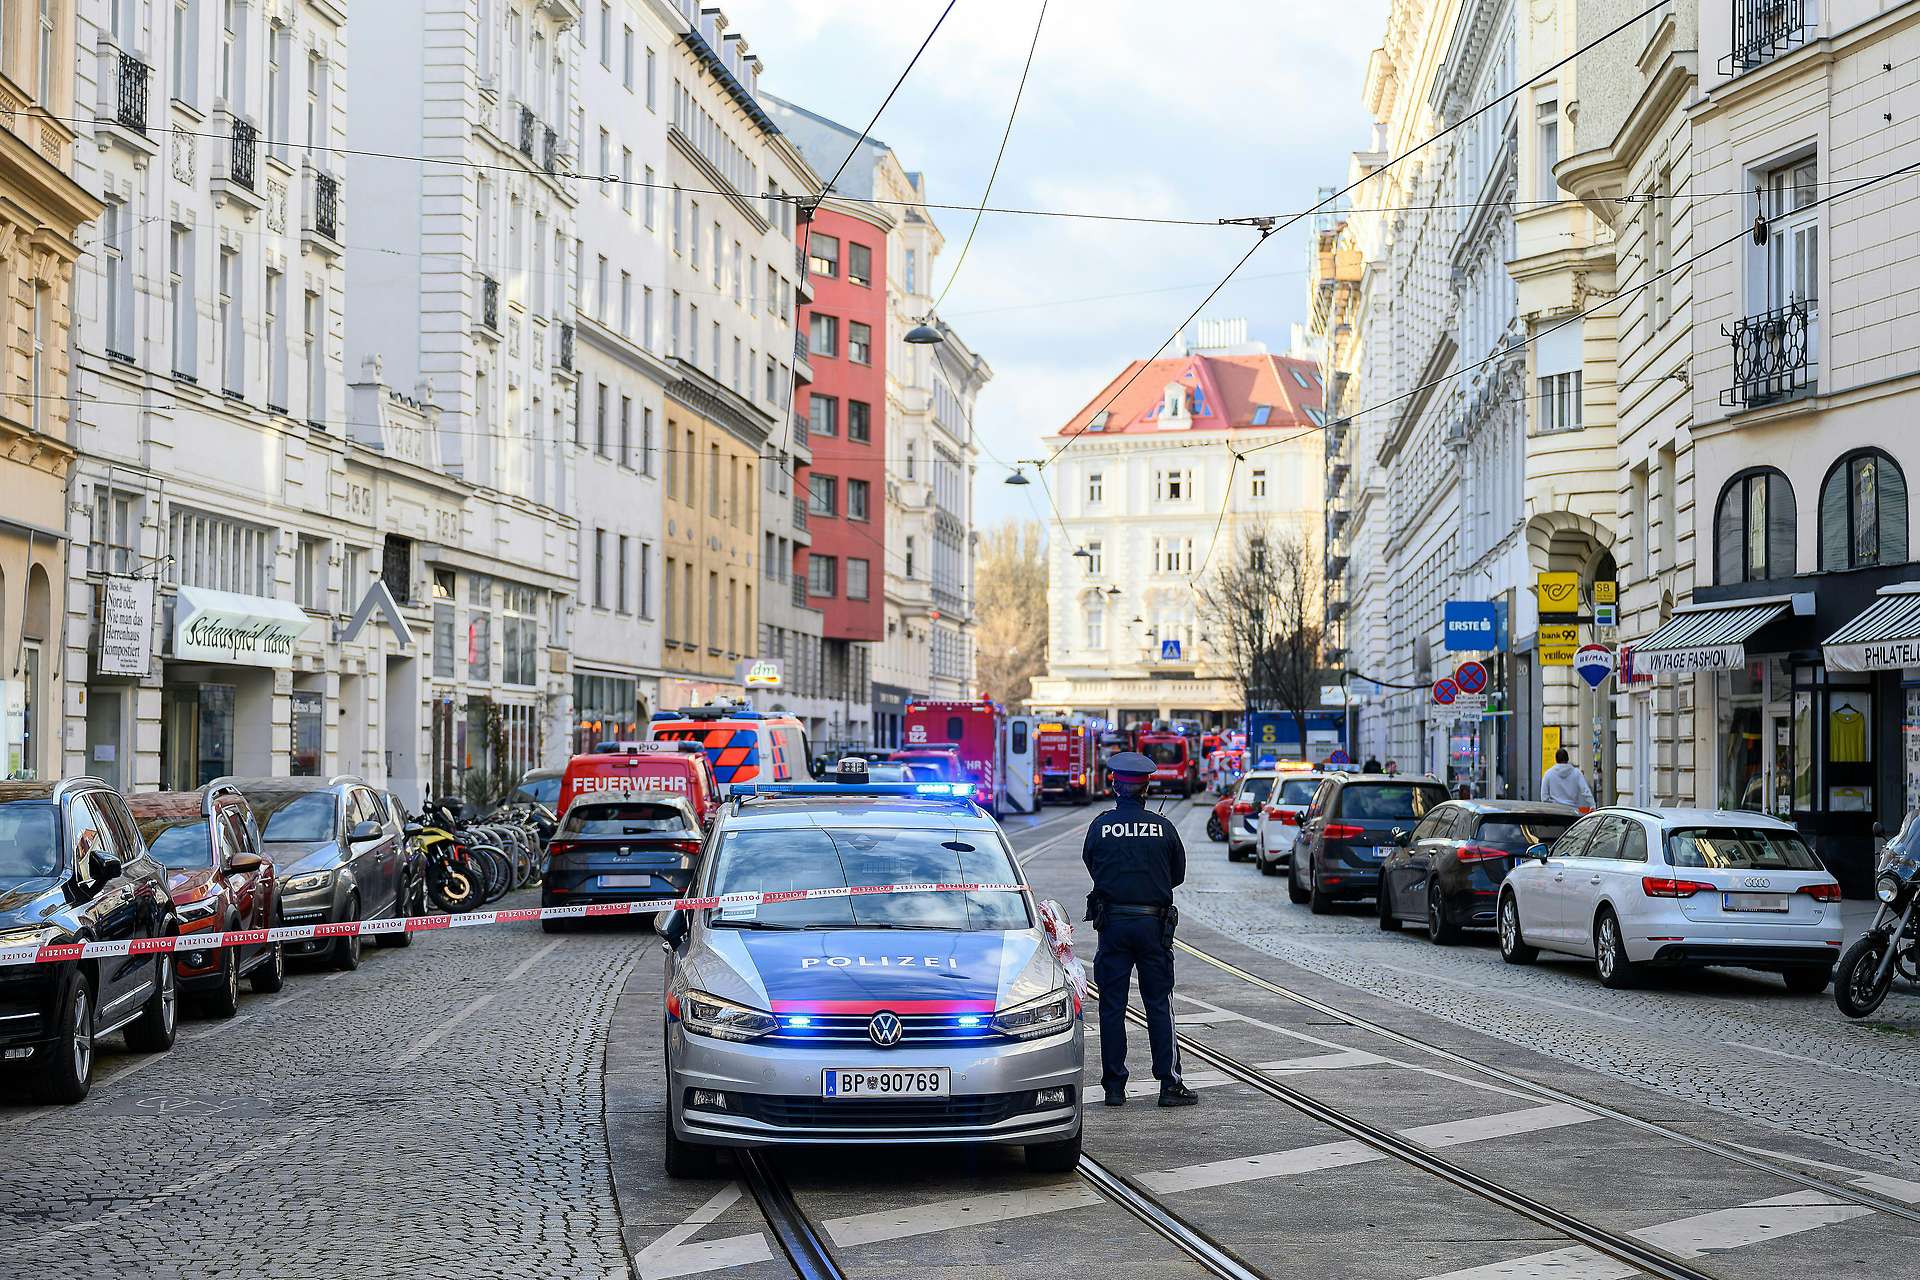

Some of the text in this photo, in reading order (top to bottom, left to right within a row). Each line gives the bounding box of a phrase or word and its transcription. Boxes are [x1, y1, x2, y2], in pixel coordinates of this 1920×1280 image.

[108, 593, 137, 609] Nora oder
[107, 608, 143, 626] Wie man das
[1449, 621, 1480, 631] ERSTE
[106, 625, 140, 641] Herrenhaus
[1562, 630, 1576, 640] 99
[186, 617, 296, 660] Schauspiel haus
[105, 641, 140, 660] kompostiert
[1580, 654, 1609, 663] RE/MAX
[1650, 653, 1686, 670] VINTAGE
[1687, 649, 1727, 668] FASHION
[753, 663, 775, 676] dm
[909, 731, 927, 743] 122
[572, 777, 687, 792] FEUERWEHR
[1101, 822, 1164, 838] POLIZEI
[683, 897, 716, 905] POLIZEI
[727, 894, 760, 902] POLIZEI
[594, 903, 628, 911] POLIZEI
[638, 900, 672, 908] POLIZEI
[504, 909, 538, 918] POLIZEI
[549, 905, 583, 914] POLIZEI
[413, 916, 447, 926] POLIZEI
[458, 913, 493, 922] POLIZEI
[322, 925, 356, 934] POLIZEI
[367, 921, 401, 930] POLIZEI
[231, 932, 264, 942] POLIZEI
[276, 929, 310, 939] POLIZEI
[138, 940, 172, 949] POLIZEI
[184, 936, 218, 946] POLIZEI
[44, 948, 79, 957] POLIZEI
[91, 944, 126, 954] POLIZEI
[801, 956, 958, 969] POLIZEI
[842, 1073, 940, 1092] BP 90769
